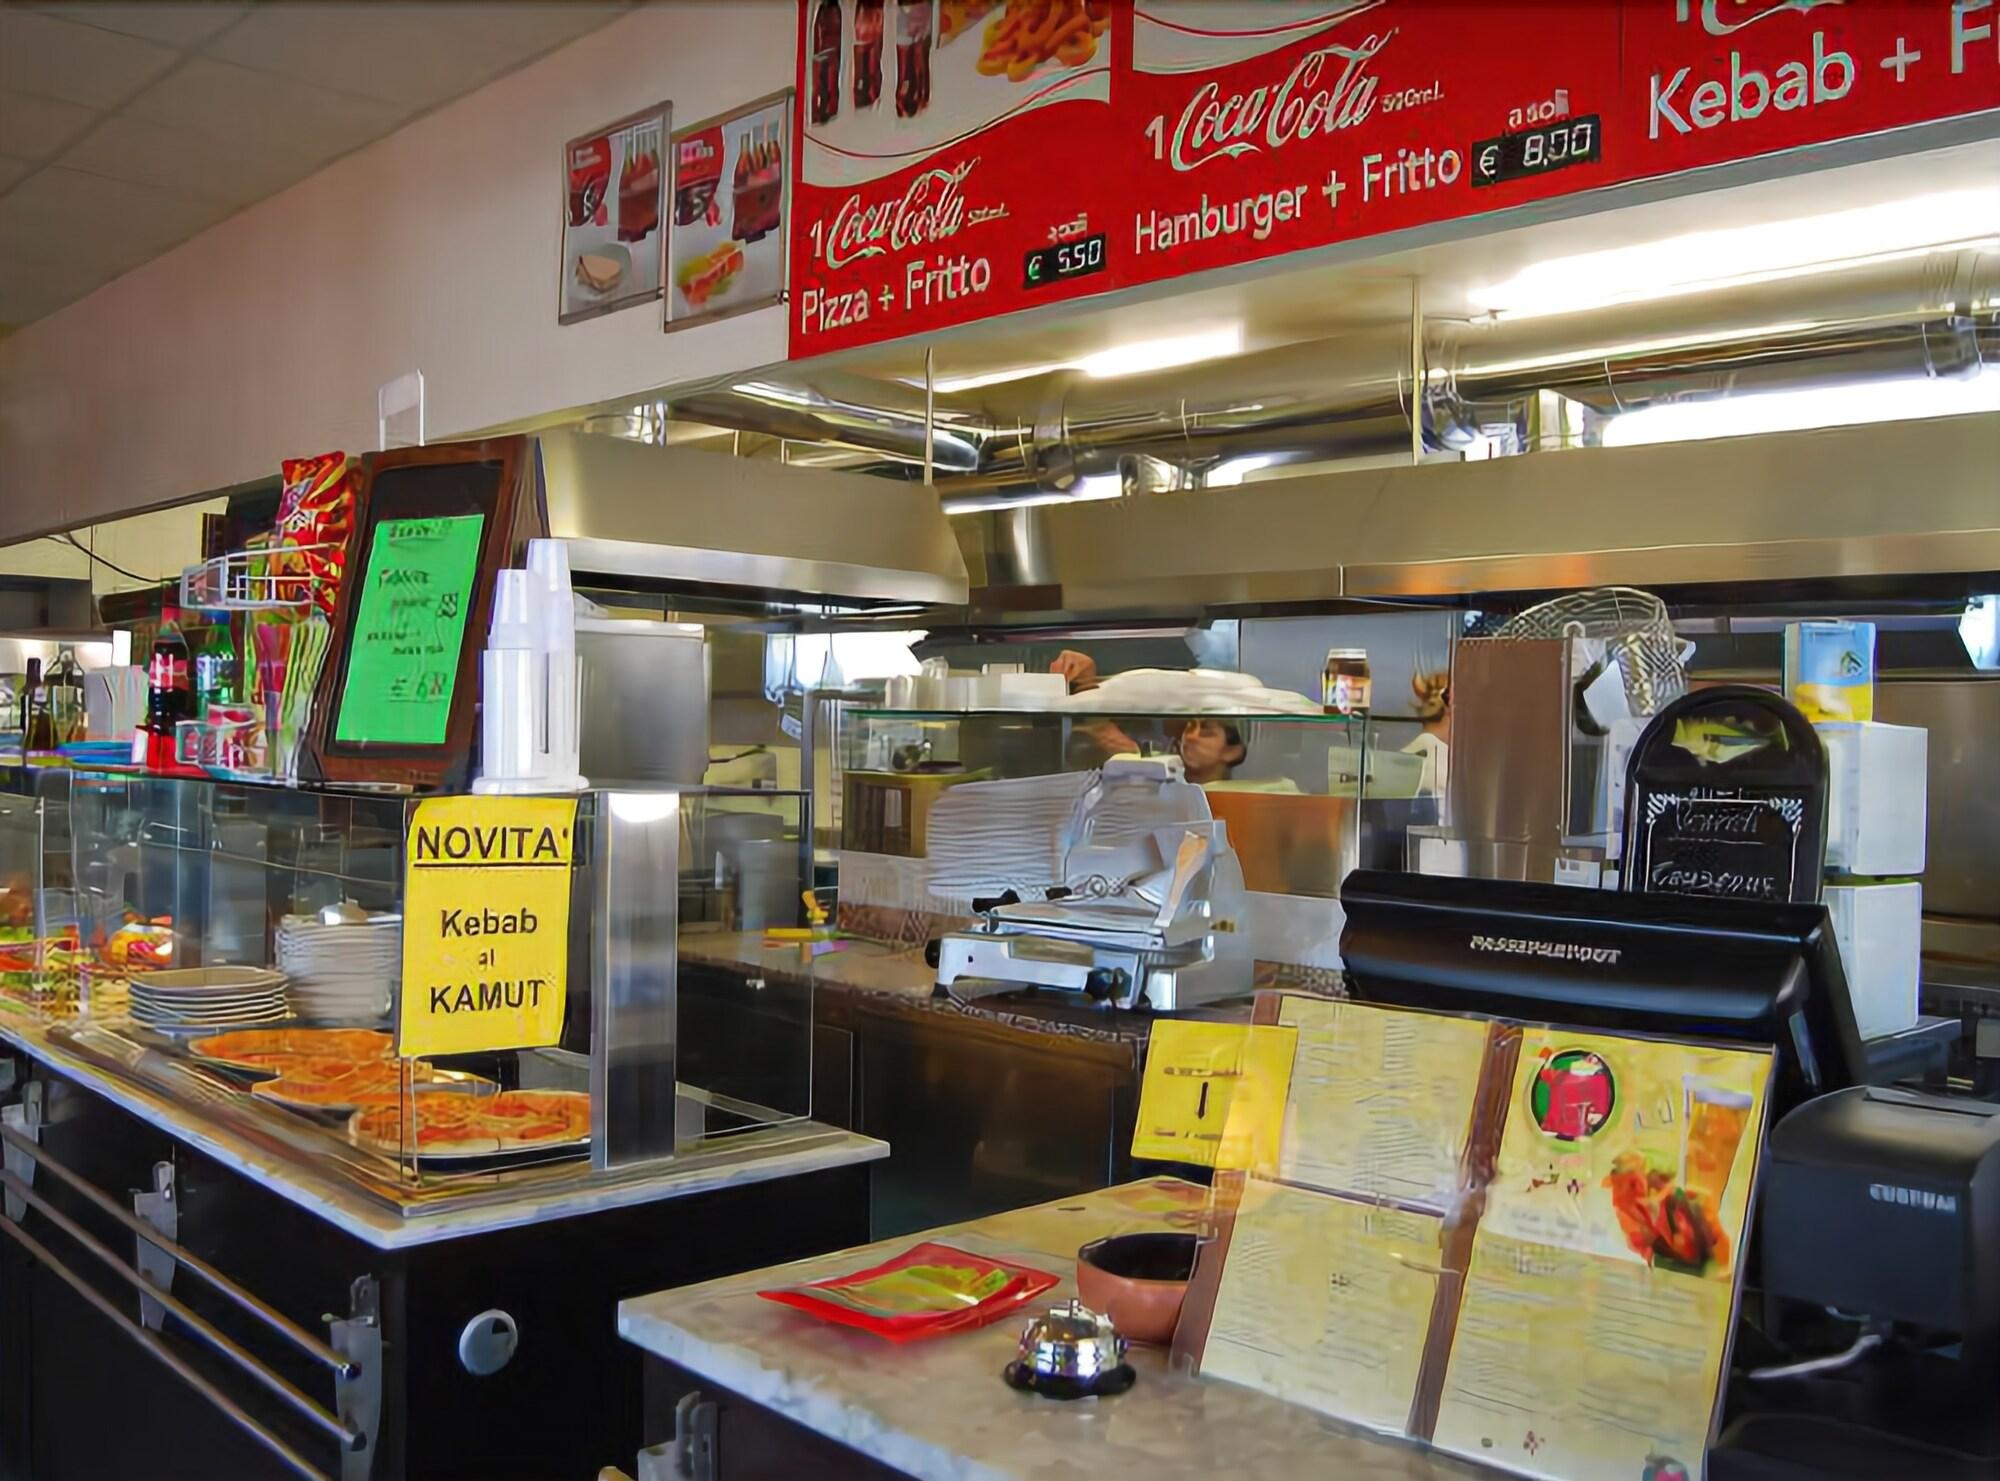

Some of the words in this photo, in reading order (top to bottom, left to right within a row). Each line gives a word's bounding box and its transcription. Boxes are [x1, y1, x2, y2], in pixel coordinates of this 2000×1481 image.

[1648, 31, 1855, 140] Kebab
[1880, 37, 1921, 83] +
[1951, 0, 2000, 75] F
[1145, 115, 1165, 160] 1
[1135, 185, 1308, 255] Hamburger
[1322, 170, 1346, 208] +
[1362, 147, 1463, 203] Fritto
[801, 287, 870, 335] Pizza
[878, 284, 895, 312] +
[905, 254, 991, 311] Fritto
[416, 825, 570, 860] NOVITA'
[440, 907, 539, 938] Kebab
[478, 948, 496, 967] al
[429, 978, 547, 1014] KAMUT
